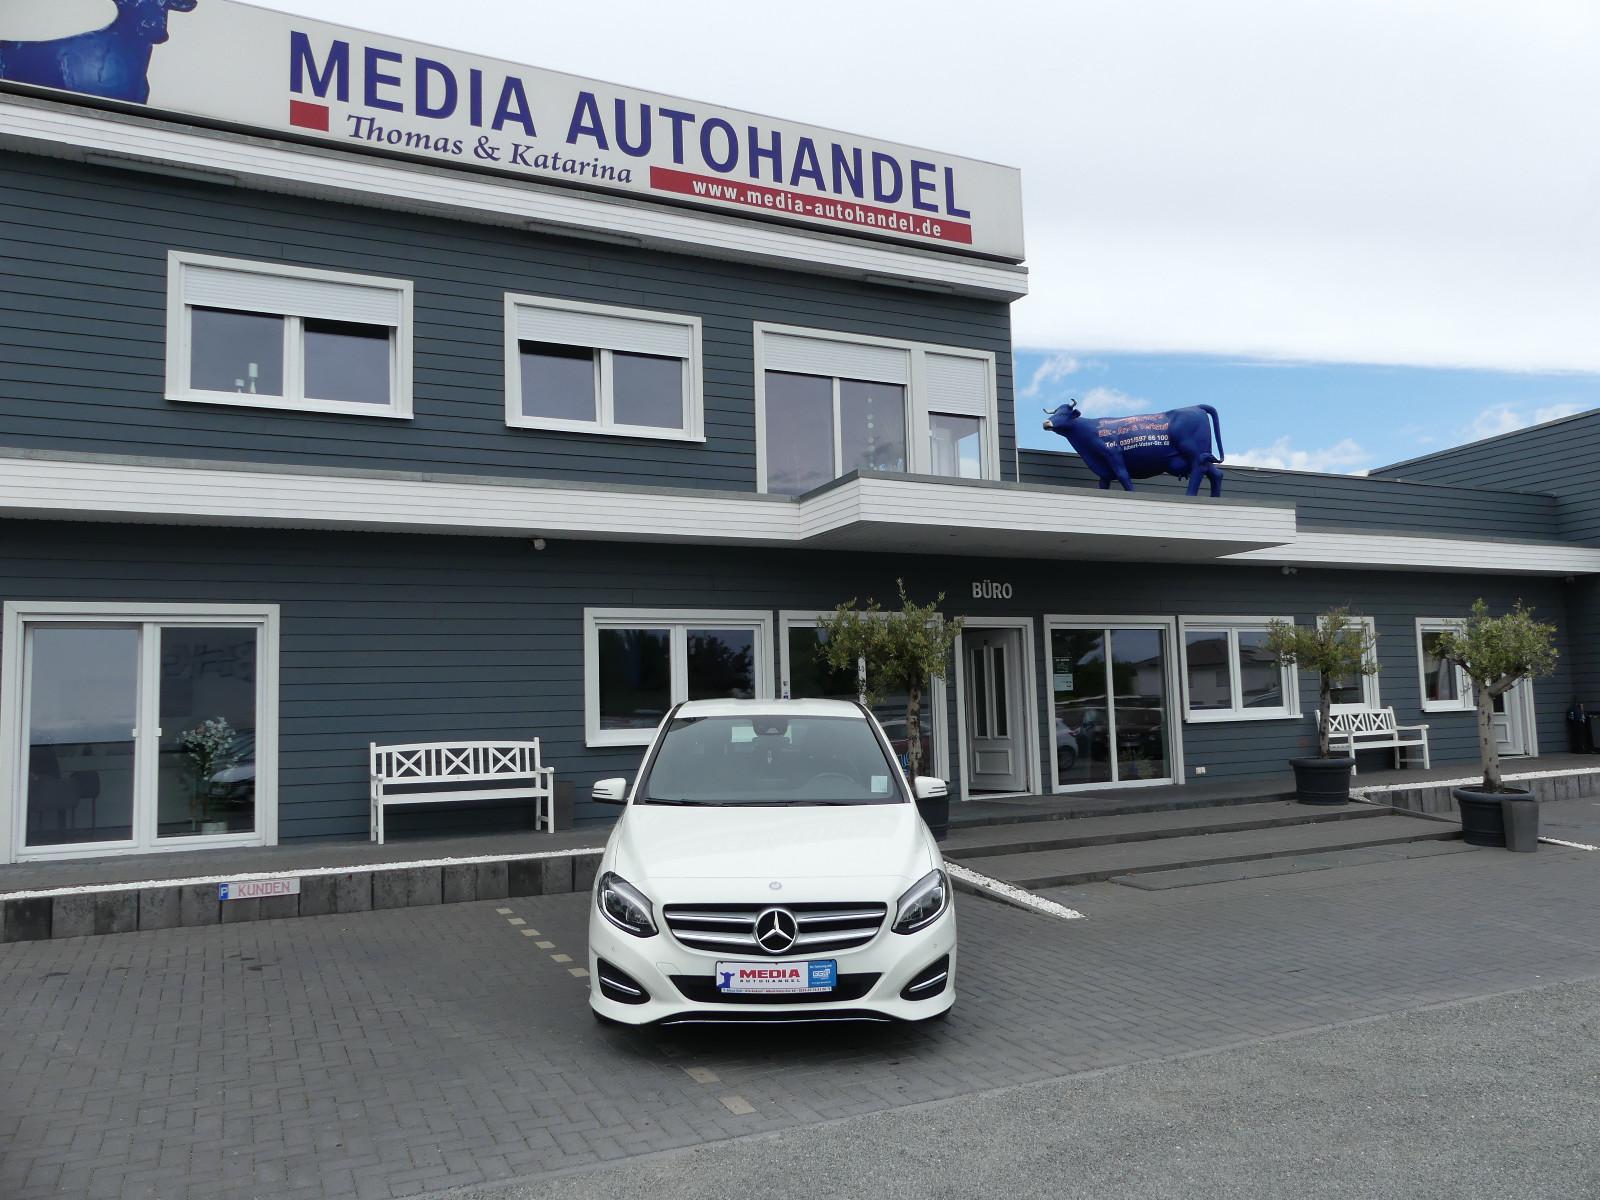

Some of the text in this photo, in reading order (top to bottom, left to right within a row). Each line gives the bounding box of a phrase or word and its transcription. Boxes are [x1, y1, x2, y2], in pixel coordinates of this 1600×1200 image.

[290, 30, 971, 219] MEDIA AUTOHANDEL
[346, 114, 633, 184] Thomas & Katarina
[692, 179, 942, 238] www.media-autohandel.de
[972, 579, 1013, 599] BÜRO
[238, 881, 291, 897] KUNDEN
[739, 969, 801, 979] MEDIA
